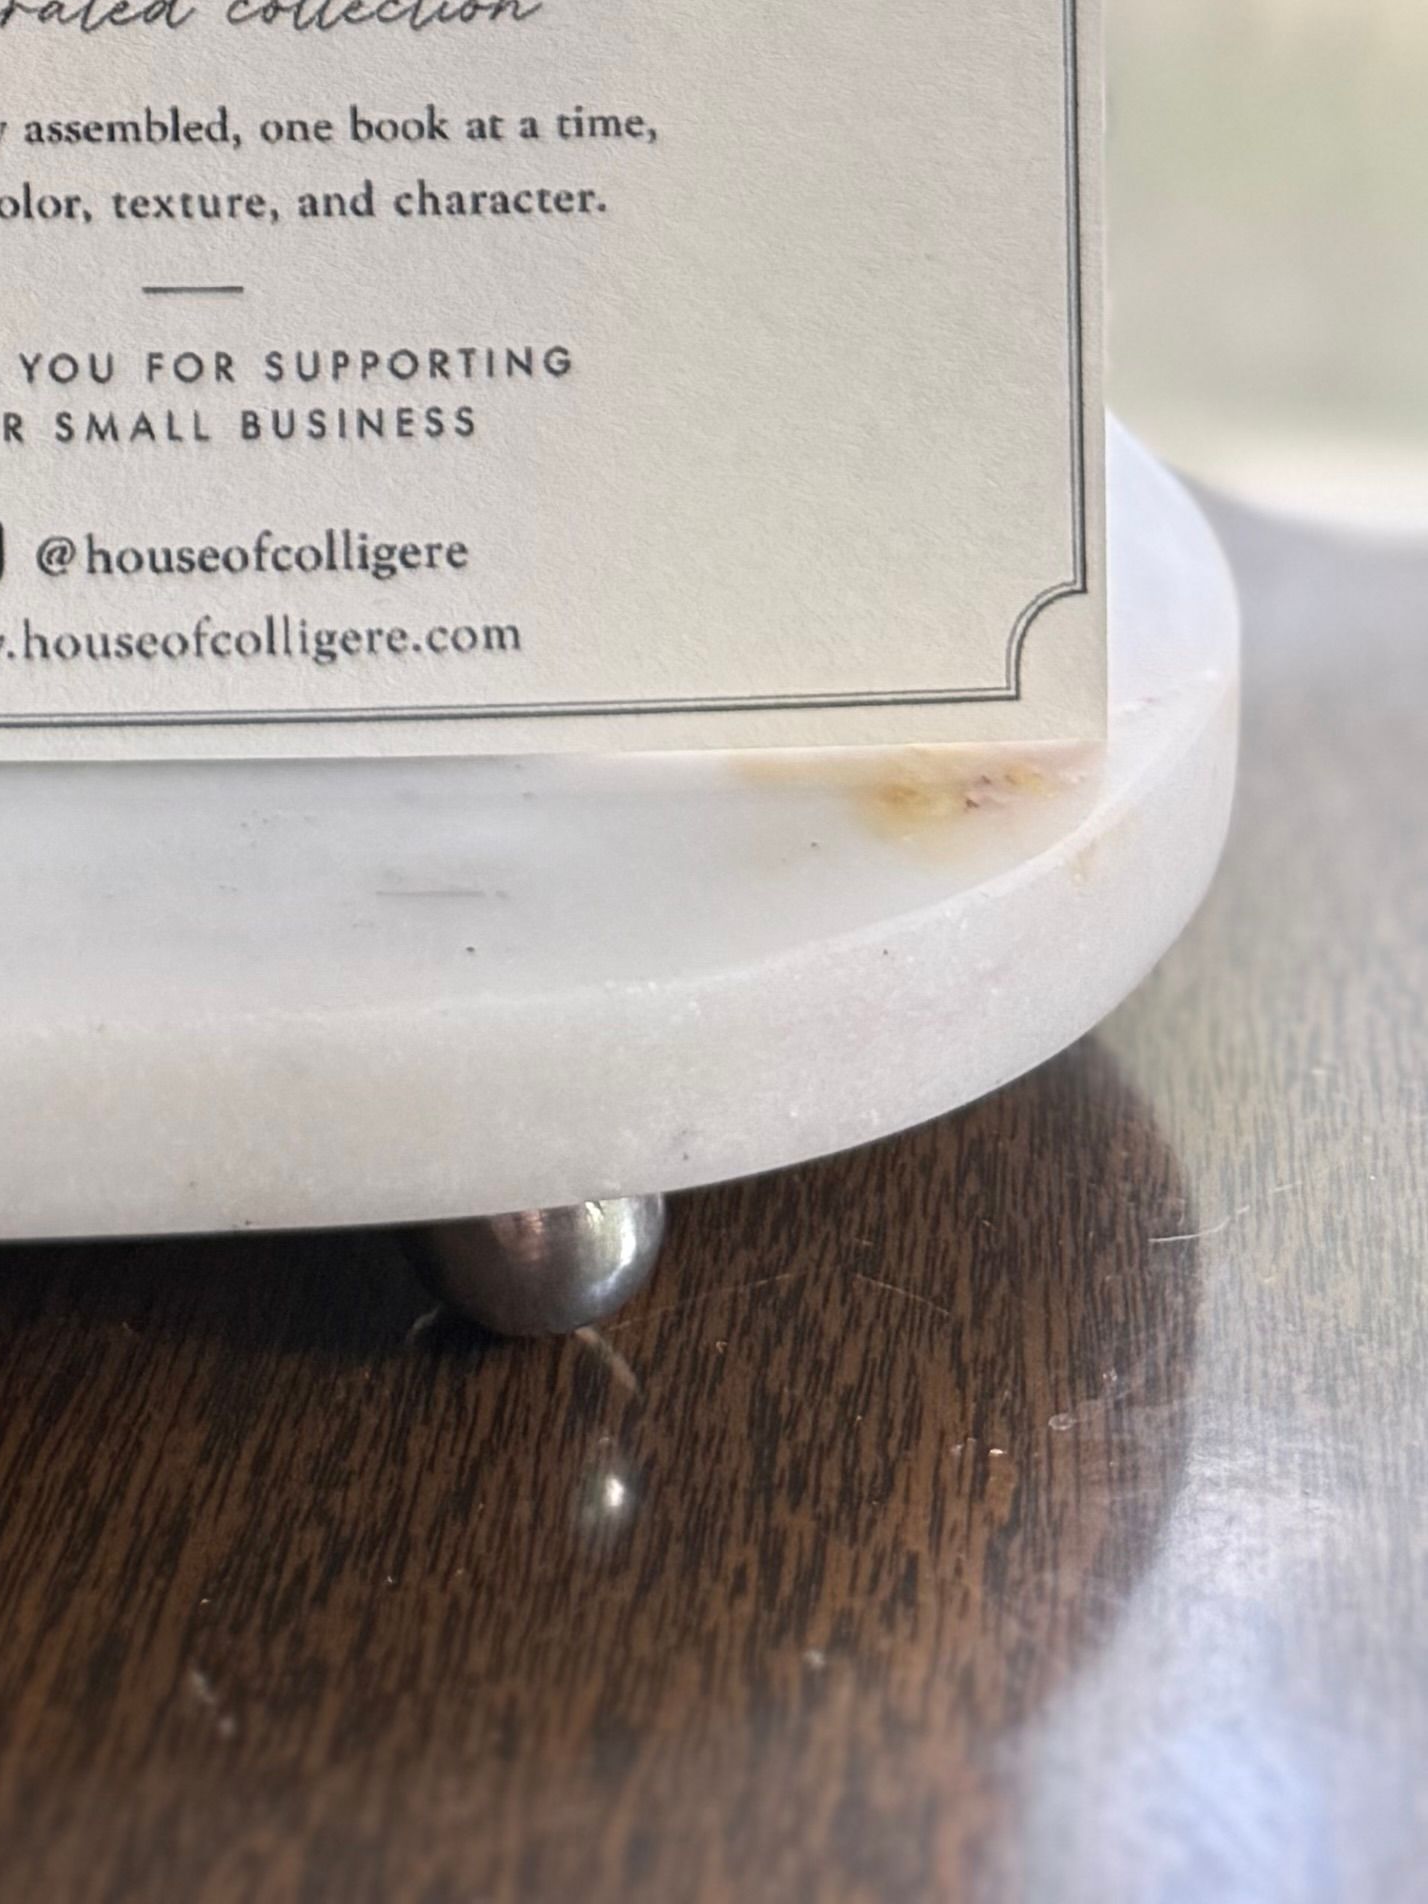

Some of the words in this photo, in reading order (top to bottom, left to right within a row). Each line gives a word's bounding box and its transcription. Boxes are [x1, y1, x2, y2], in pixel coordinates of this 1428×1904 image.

[24, 105, 242, 150] assembled,
[259, 118, 333, 143] one
[349, 104, 450, 143] book
[465, 113, 504, 141] at
[519, 117, 539, 140] a
[557, 105, 658, 143] time,
[113, 191, 280, 223] texture,
[297, 178, 375, 218] and
[393, 178, 607, 216] character.
[20, 351, 116, 386] YOU
[146, 349, 237, 384] FOR
[264, 344, 576, 382] SUPPORTING
[54, 409, 213, 443] SMALL
[241, 406, 479, 442] BUSINESS
[35, 528, 469, 580] @houseofcolligere
